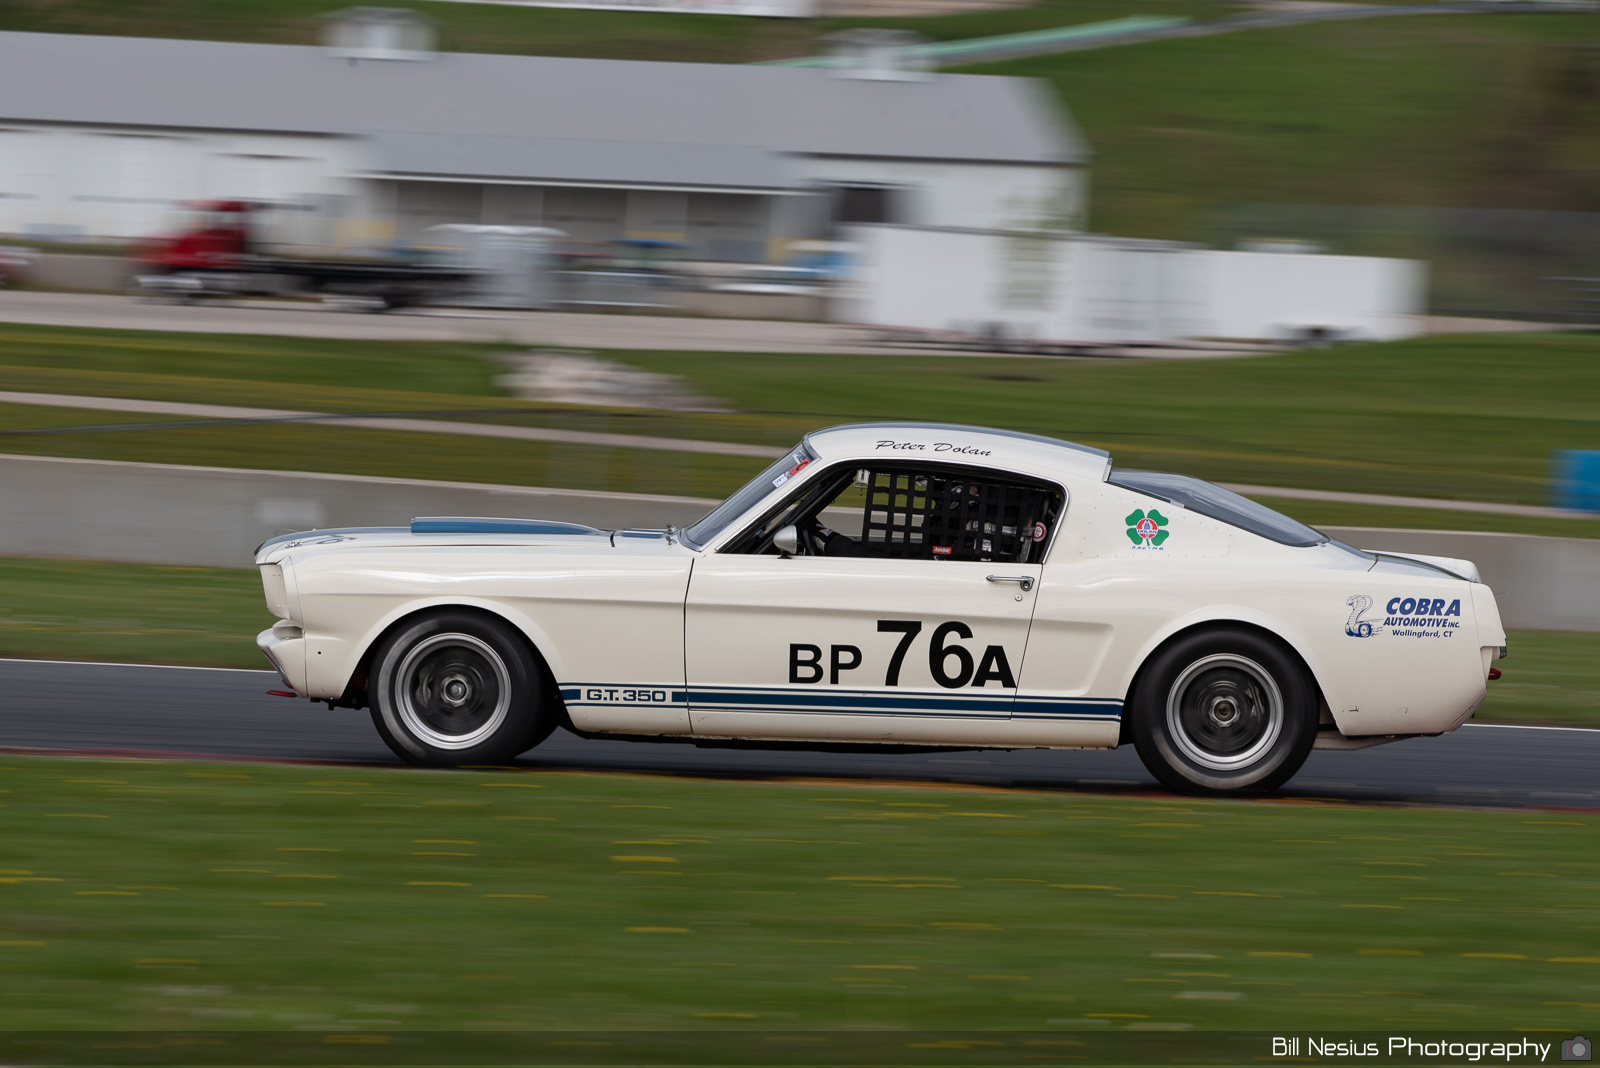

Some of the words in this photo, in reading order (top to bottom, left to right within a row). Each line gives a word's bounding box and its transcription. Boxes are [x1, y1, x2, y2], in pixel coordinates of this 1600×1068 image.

[876, 440, 926, 451] Peter
[934, 443, 992, 457] Dolan
[1386, 597, 1461, 616] COBRA
[1383, 617, 1448, 628] AUTOMOTIVE
[1392, 629, 1441, 639] Wallingford,
[1443, 630, 1453, 638] CT
[789, 643, 863, 685] BP
[623, 690, 666, 702] 350
